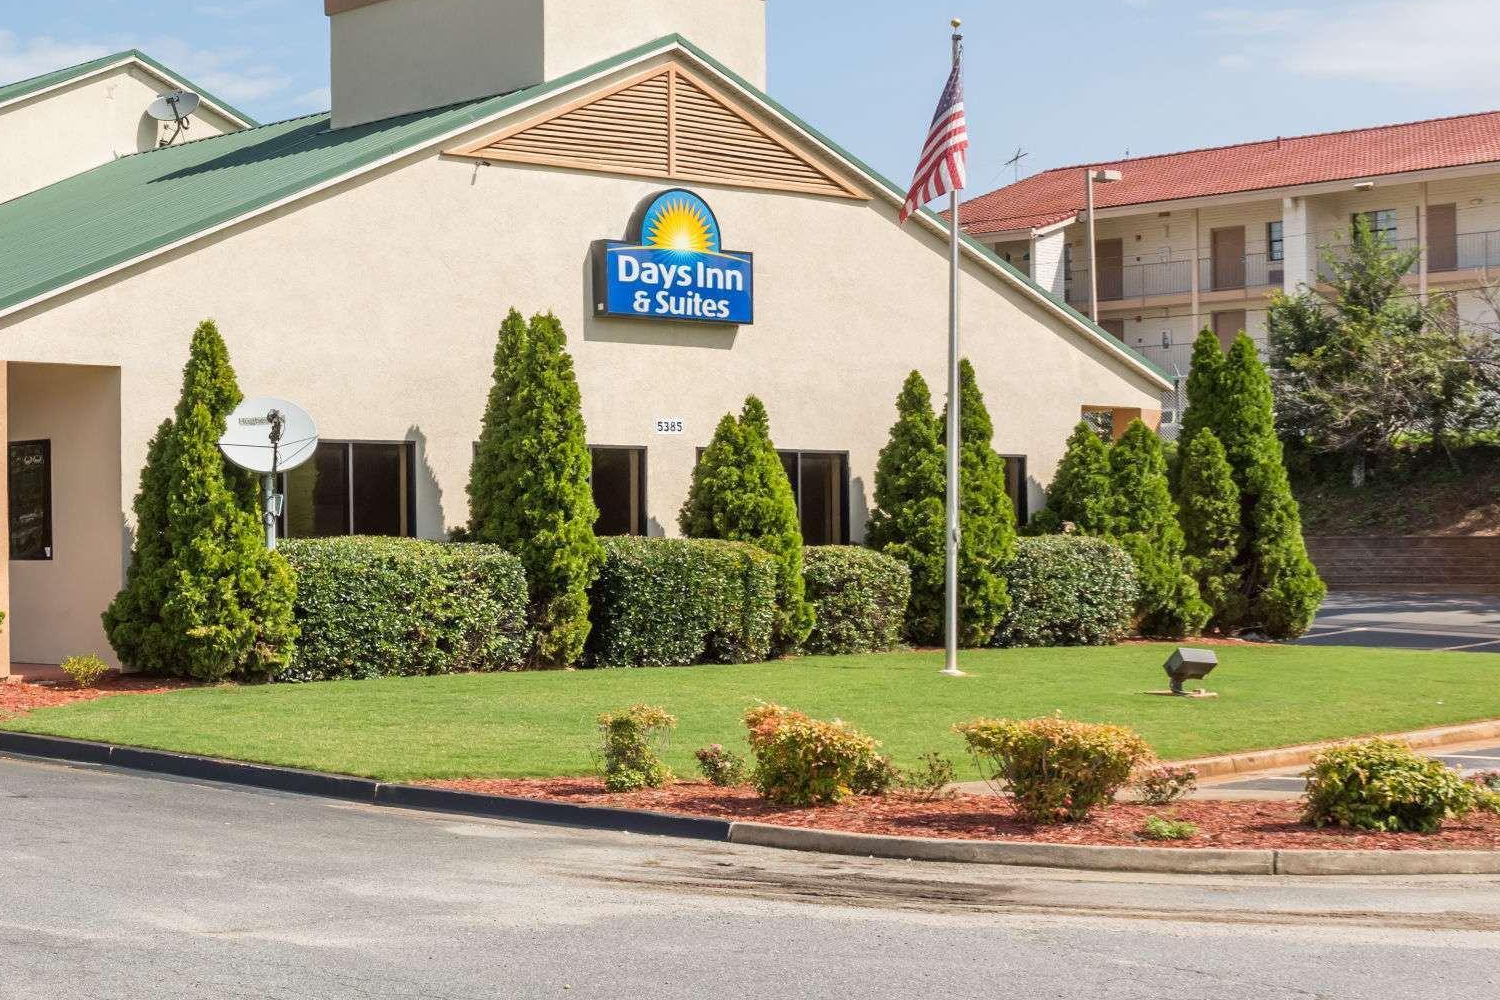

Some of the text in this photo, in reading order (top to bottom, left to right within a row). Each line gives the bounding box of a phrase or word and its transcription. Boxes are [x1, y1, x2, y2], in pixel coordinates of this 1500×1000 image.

[617, 254, 743, 291] Days Inn
[632, 290, 730, 318] & Suites
[657, 421, 682, 432] 5385
